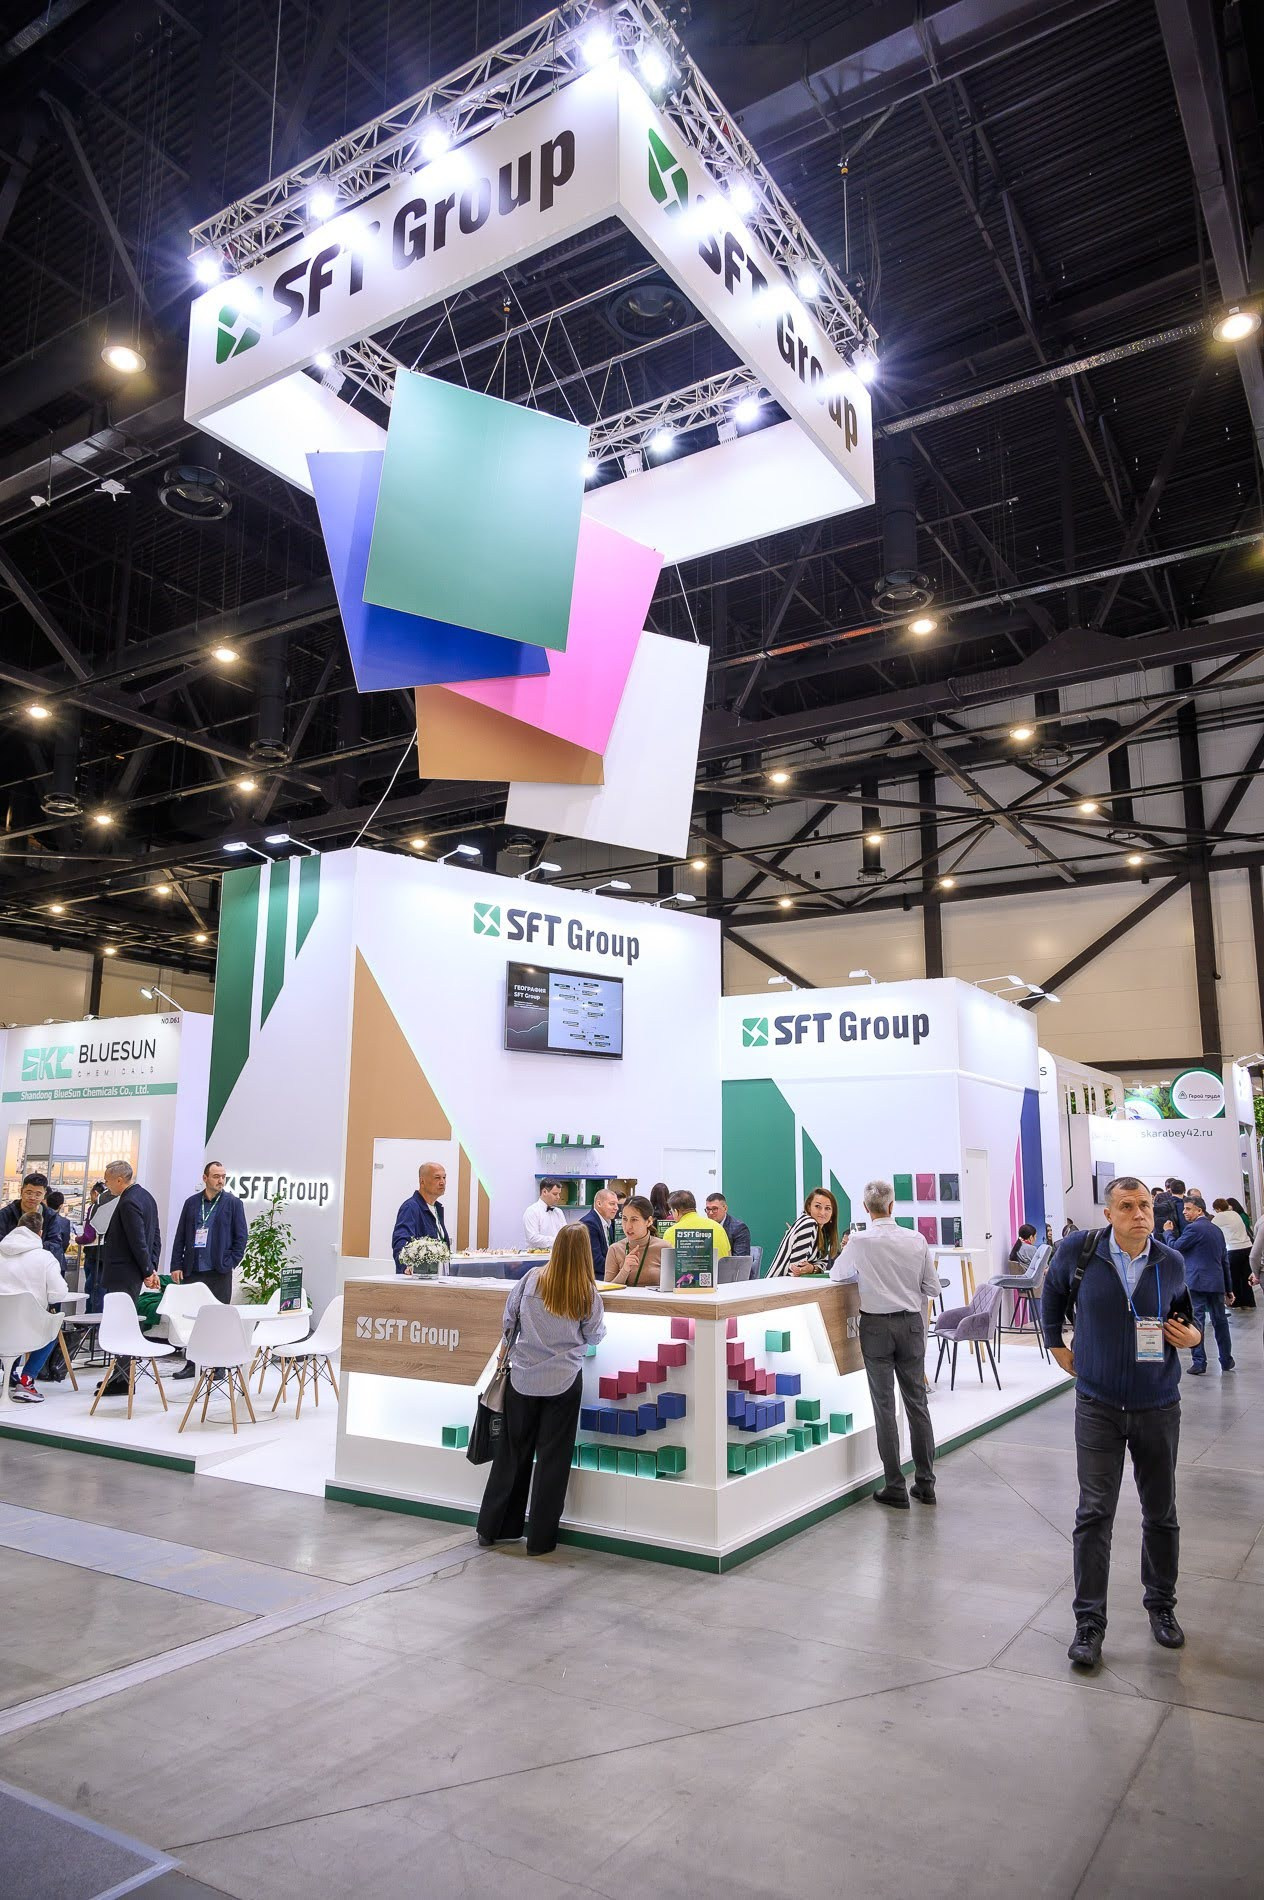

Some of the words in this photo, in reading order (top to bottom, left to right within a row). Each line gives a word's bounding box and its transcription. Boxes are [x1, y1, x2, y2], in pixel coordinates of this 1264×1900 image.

[392, 129, 576, 271] Group
[506, 908, 562, 947] SFT
[567, 918, 640, 966] Group
[524, 992, 541, 1001] Group
[774, 1012, 833, 1045] SFT
[839, 1011, 930, 1045] Group
[78, 1038, 156, 1064] BLUESUN
[77, 1066, 155, 1078] CHEMICALS
[20, 1090, 53, 1101] Shandong
[53, 1089, 81, 1099] BlueSun
[82, 1086, 119, 1097] Chemicals
[135, 1084, 150, 1095] Ltd.
[1140, 1128, 1214, 1139] skarabey42.ru
[239, 1176, 273, 1200] SFT
[277, 1176, 329, 1206] Group
[374, 1317, 408, 1342] SFT
[409, 1320, 460, 1352] Group
